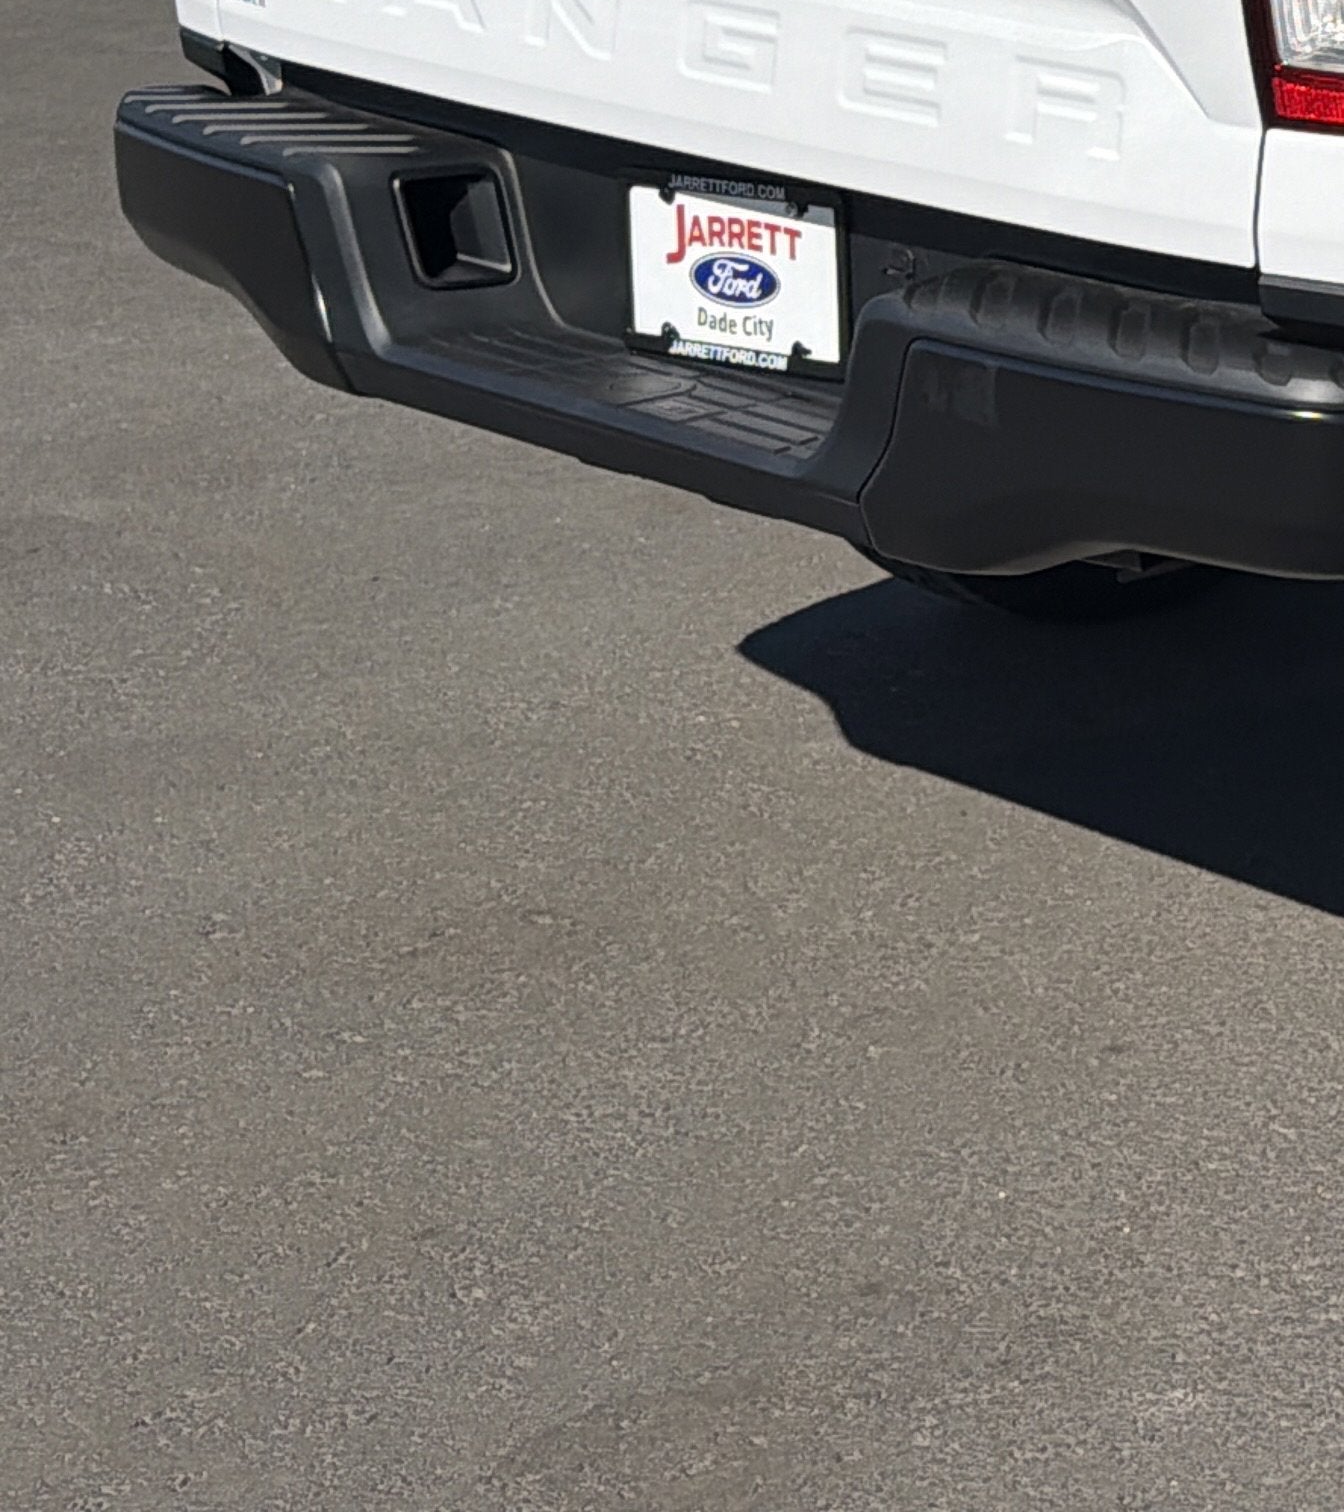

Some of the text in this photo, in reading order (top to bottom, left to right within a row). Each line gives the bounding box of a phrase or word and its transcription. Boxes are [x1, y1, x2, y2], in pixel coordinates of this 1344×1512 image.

[668, 173, 786, 201] JARRETTFORD.COM
[666, 204, 803, 264] JARRETT
[707, 258, 764, 299] Ford
[697, 307, 774, 342] Dade City
[668, 339, 788, 371] JARRETTFORD.COM
